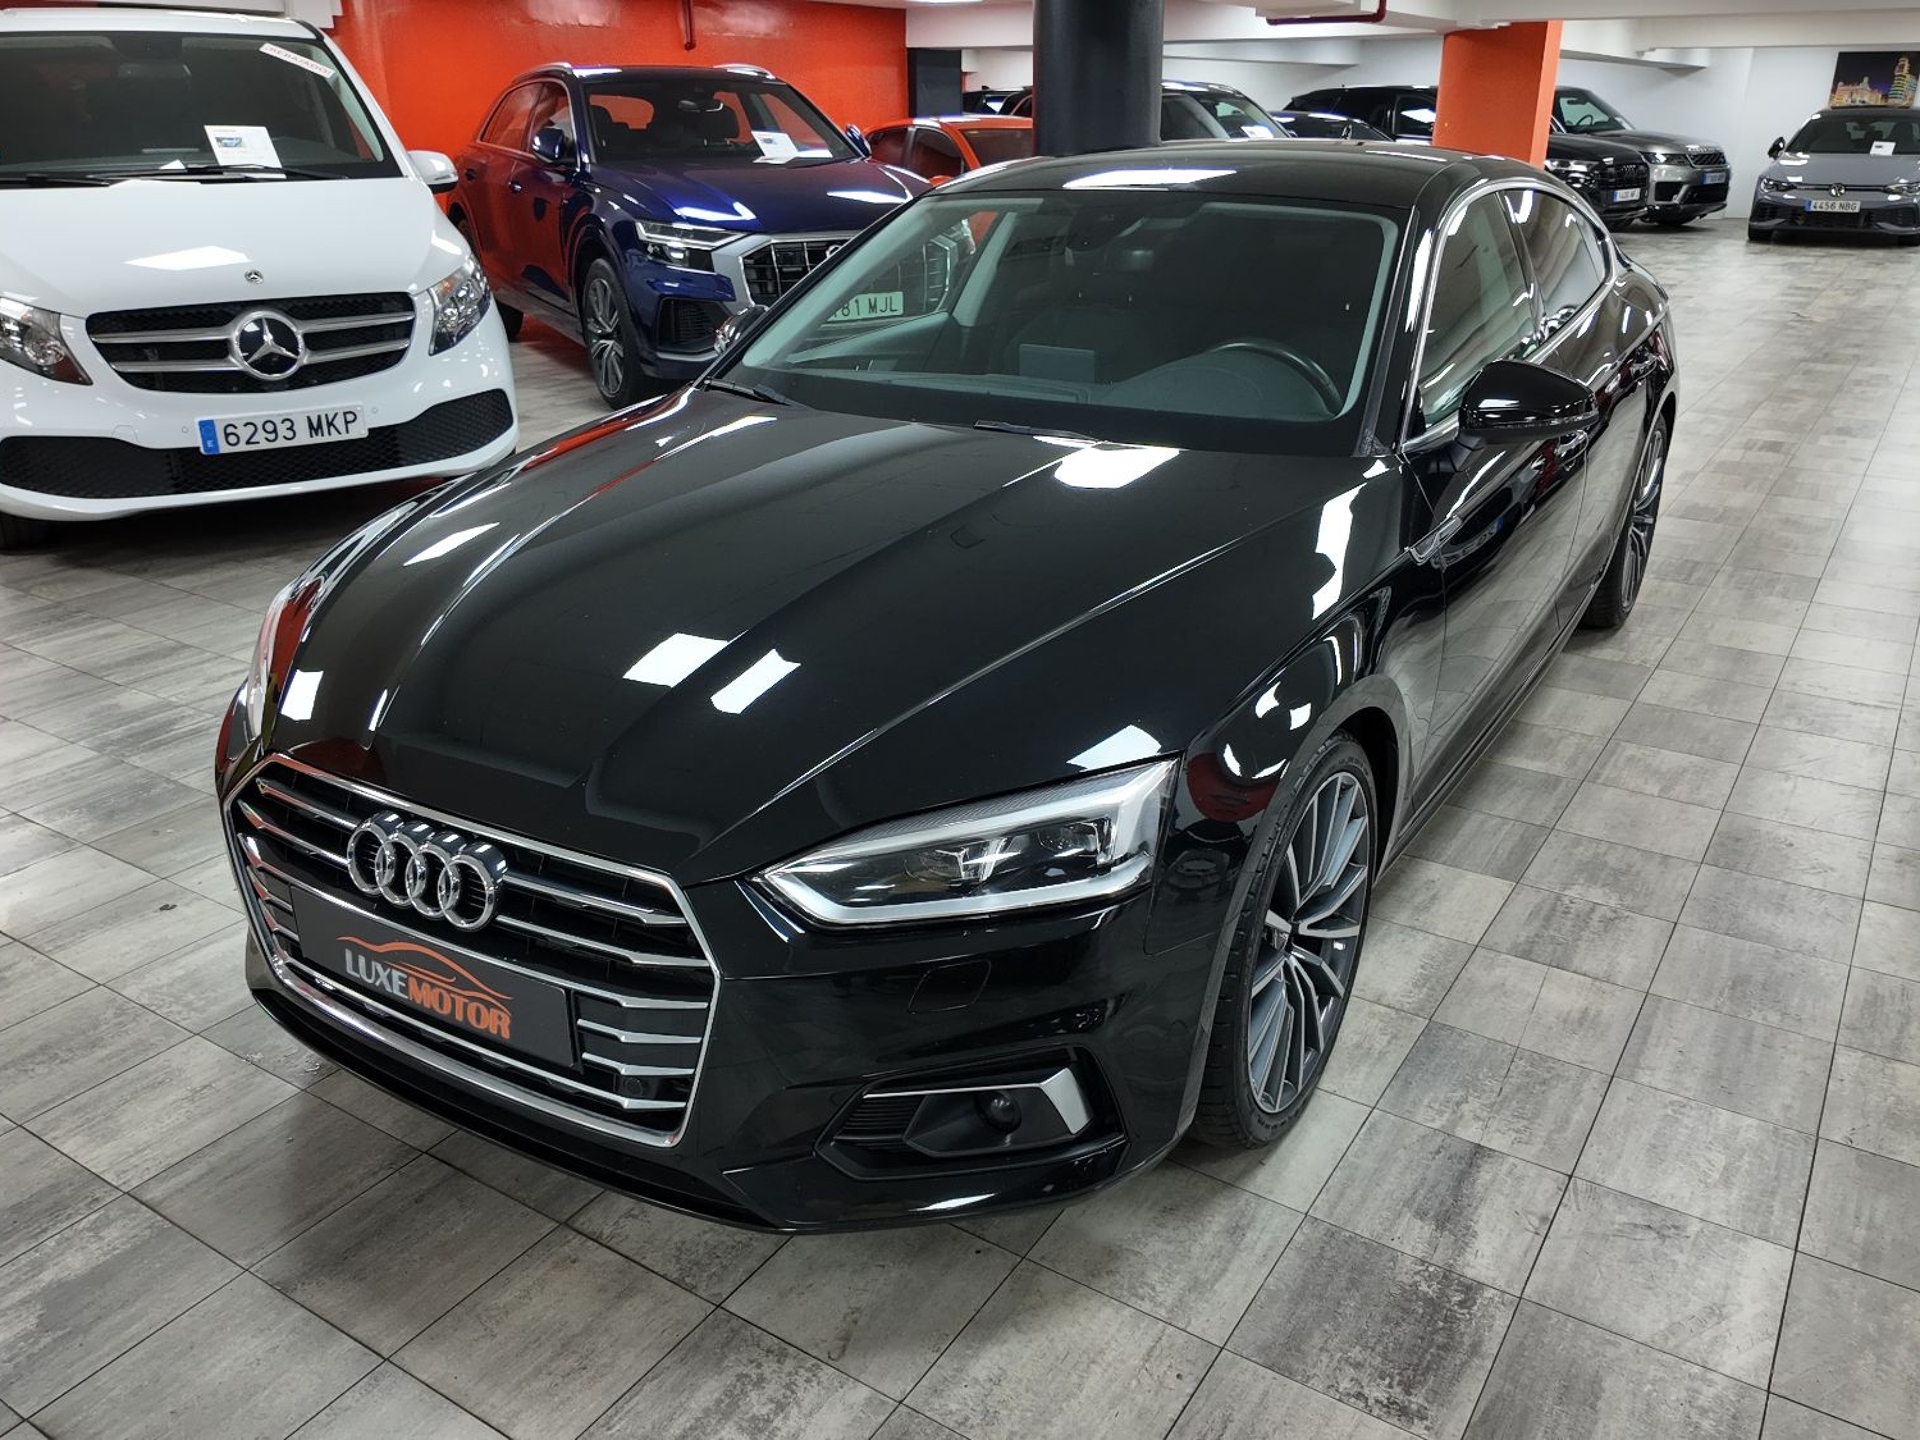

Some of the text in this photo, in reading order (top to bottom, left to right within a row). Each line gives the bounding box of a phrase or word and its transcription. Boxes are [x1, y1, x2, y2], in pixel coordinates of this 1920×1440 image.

[834, 296, 899, 318] 81 MJL
[223, 416, 297, 447] 6293
[306, 410, 358, 438] MKP
[345, 948, 511, 1040] LUXEMOTOR
